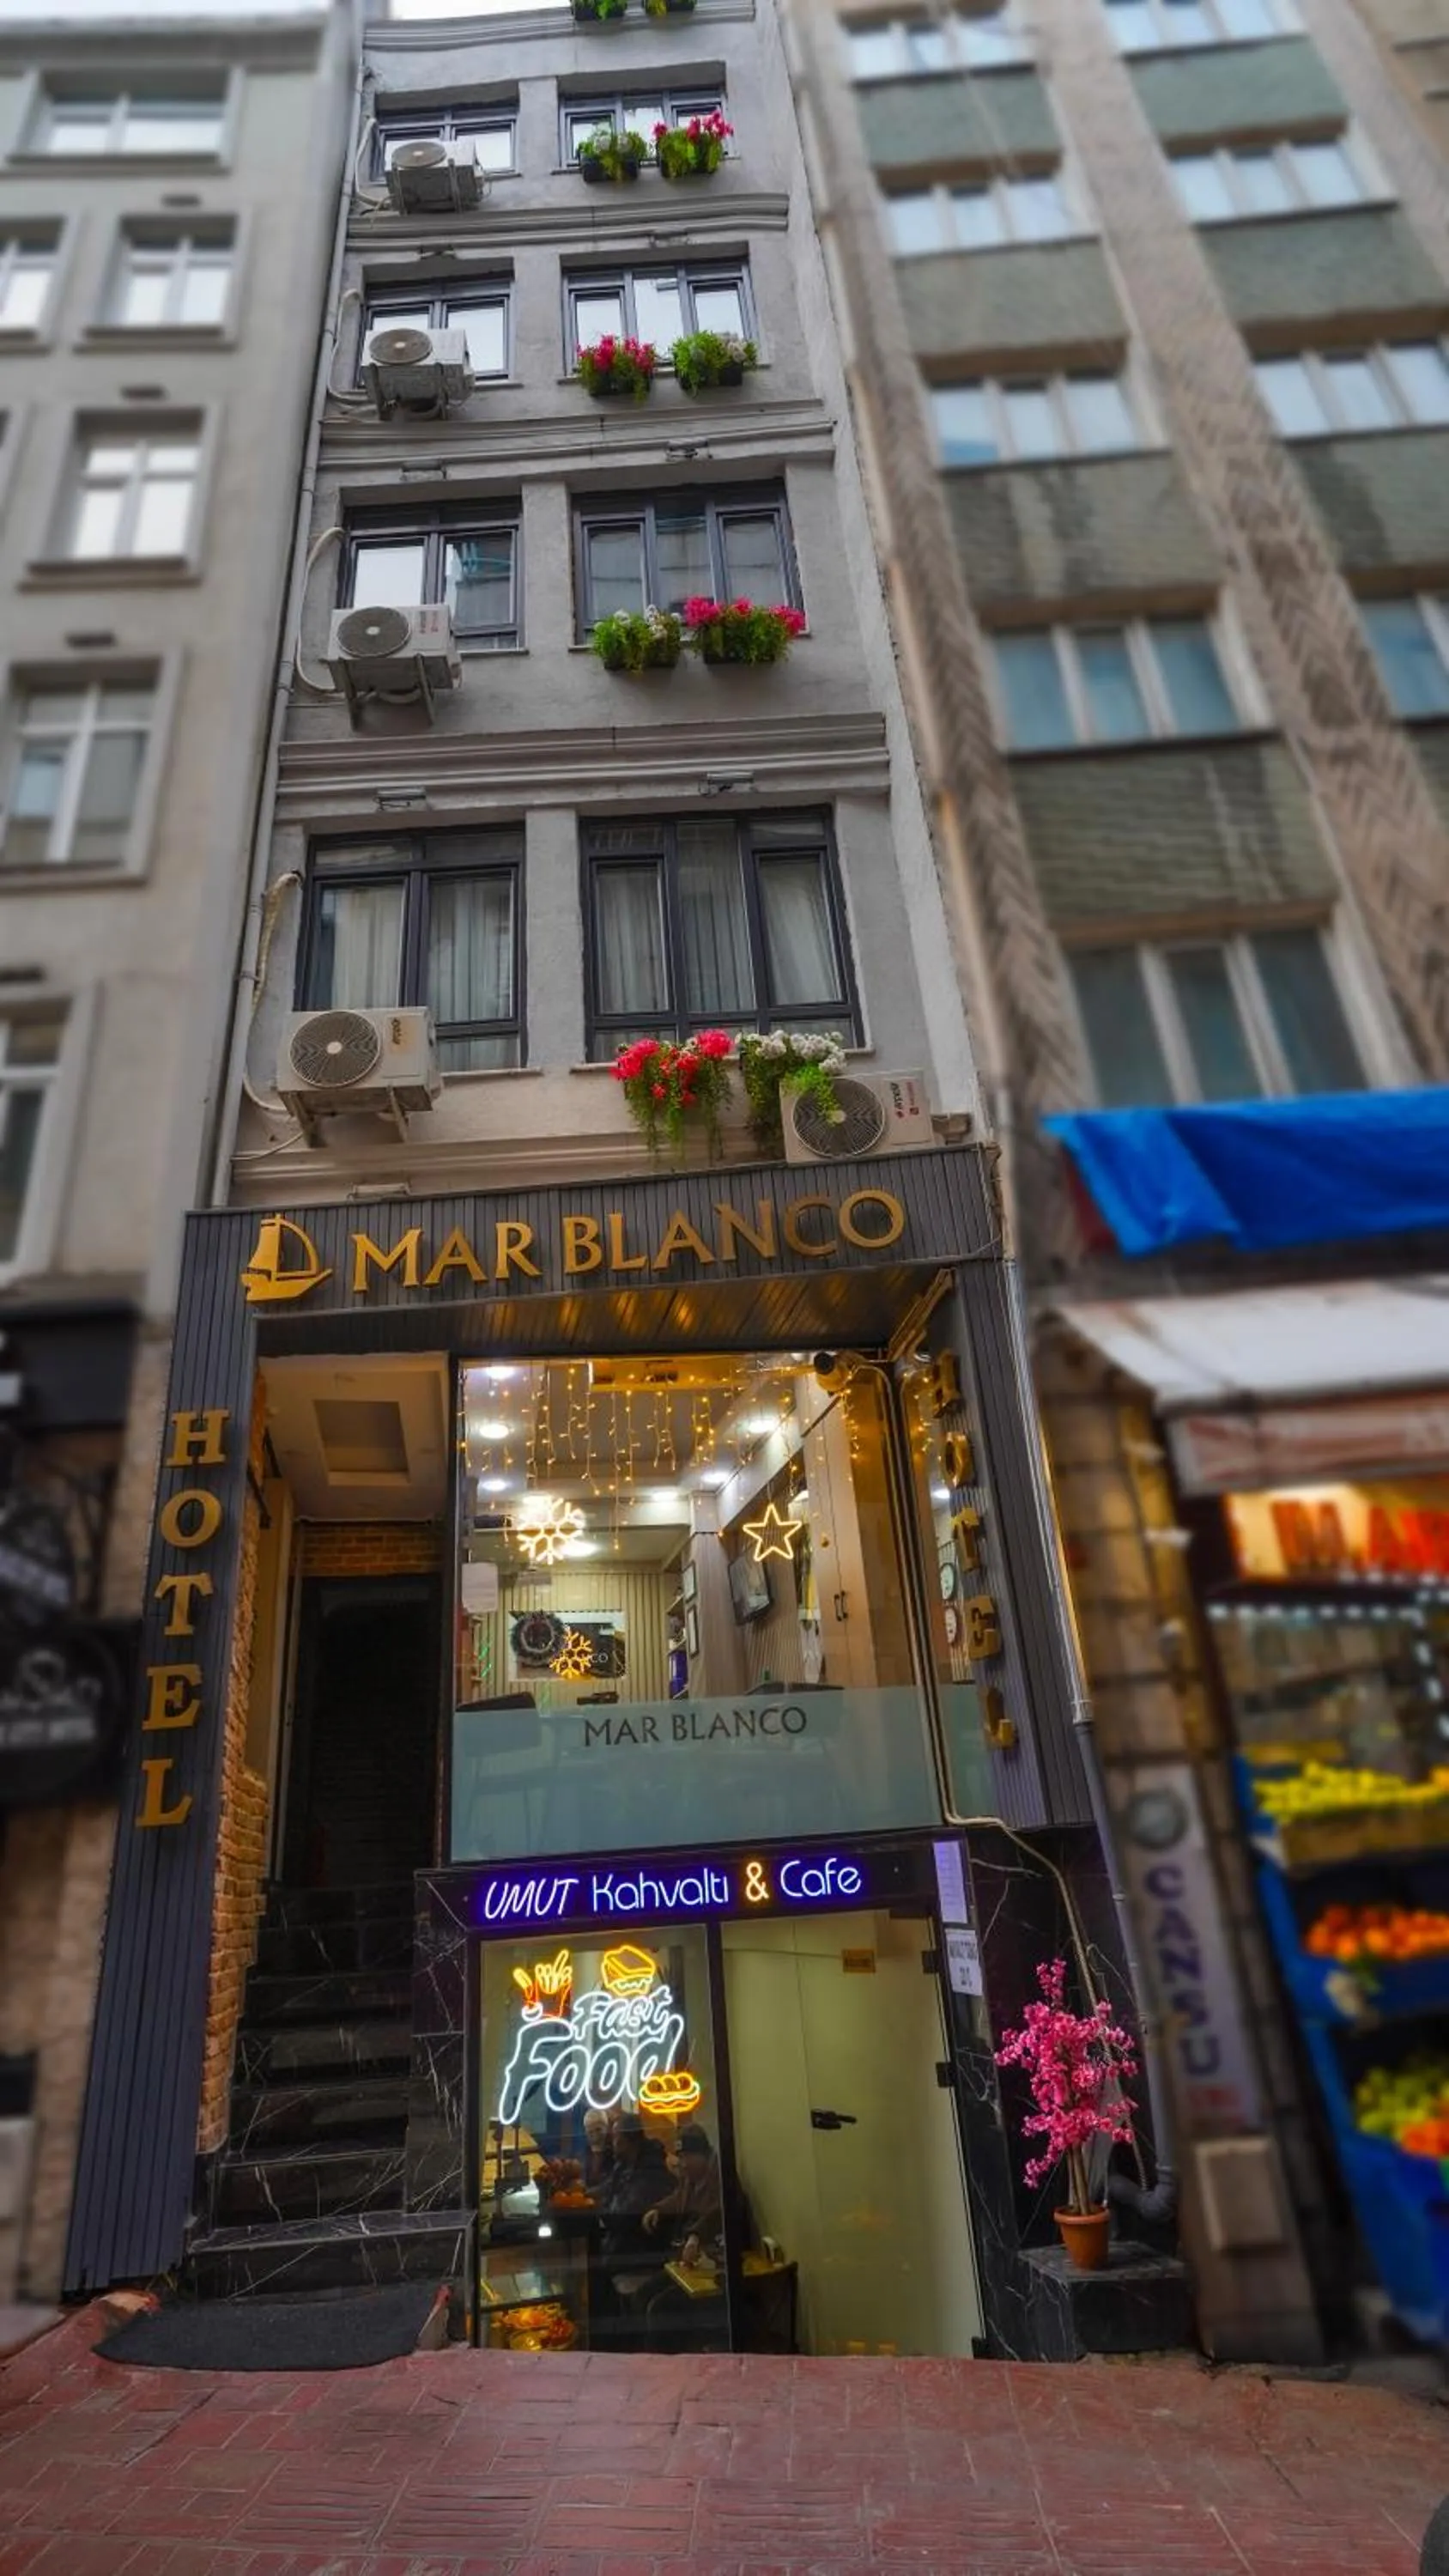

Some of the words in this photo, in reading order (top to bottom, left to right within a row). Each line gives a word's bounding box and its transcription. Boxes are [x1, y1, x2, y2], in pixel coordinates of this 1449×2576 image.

[350, 1222, 543, 1291] MAR
[562, 1188, 905, 1274] BLANCO
[135, 1408, 230, 1828] HOTEL
[584, 1716, 660, 1747] MAR
[671, 1706, 807, 1741] BLANCO
[484, 1878, 579, 1919] UMUT
[592, 1868, 729, 1911] Kahvaltı
[745, 1862, 769, 1901] &
[780, 1857, 862, 1898] Cafe
[572, 1985, 672, 2040] Fast
[499, 2014, 684, 2124] Food
